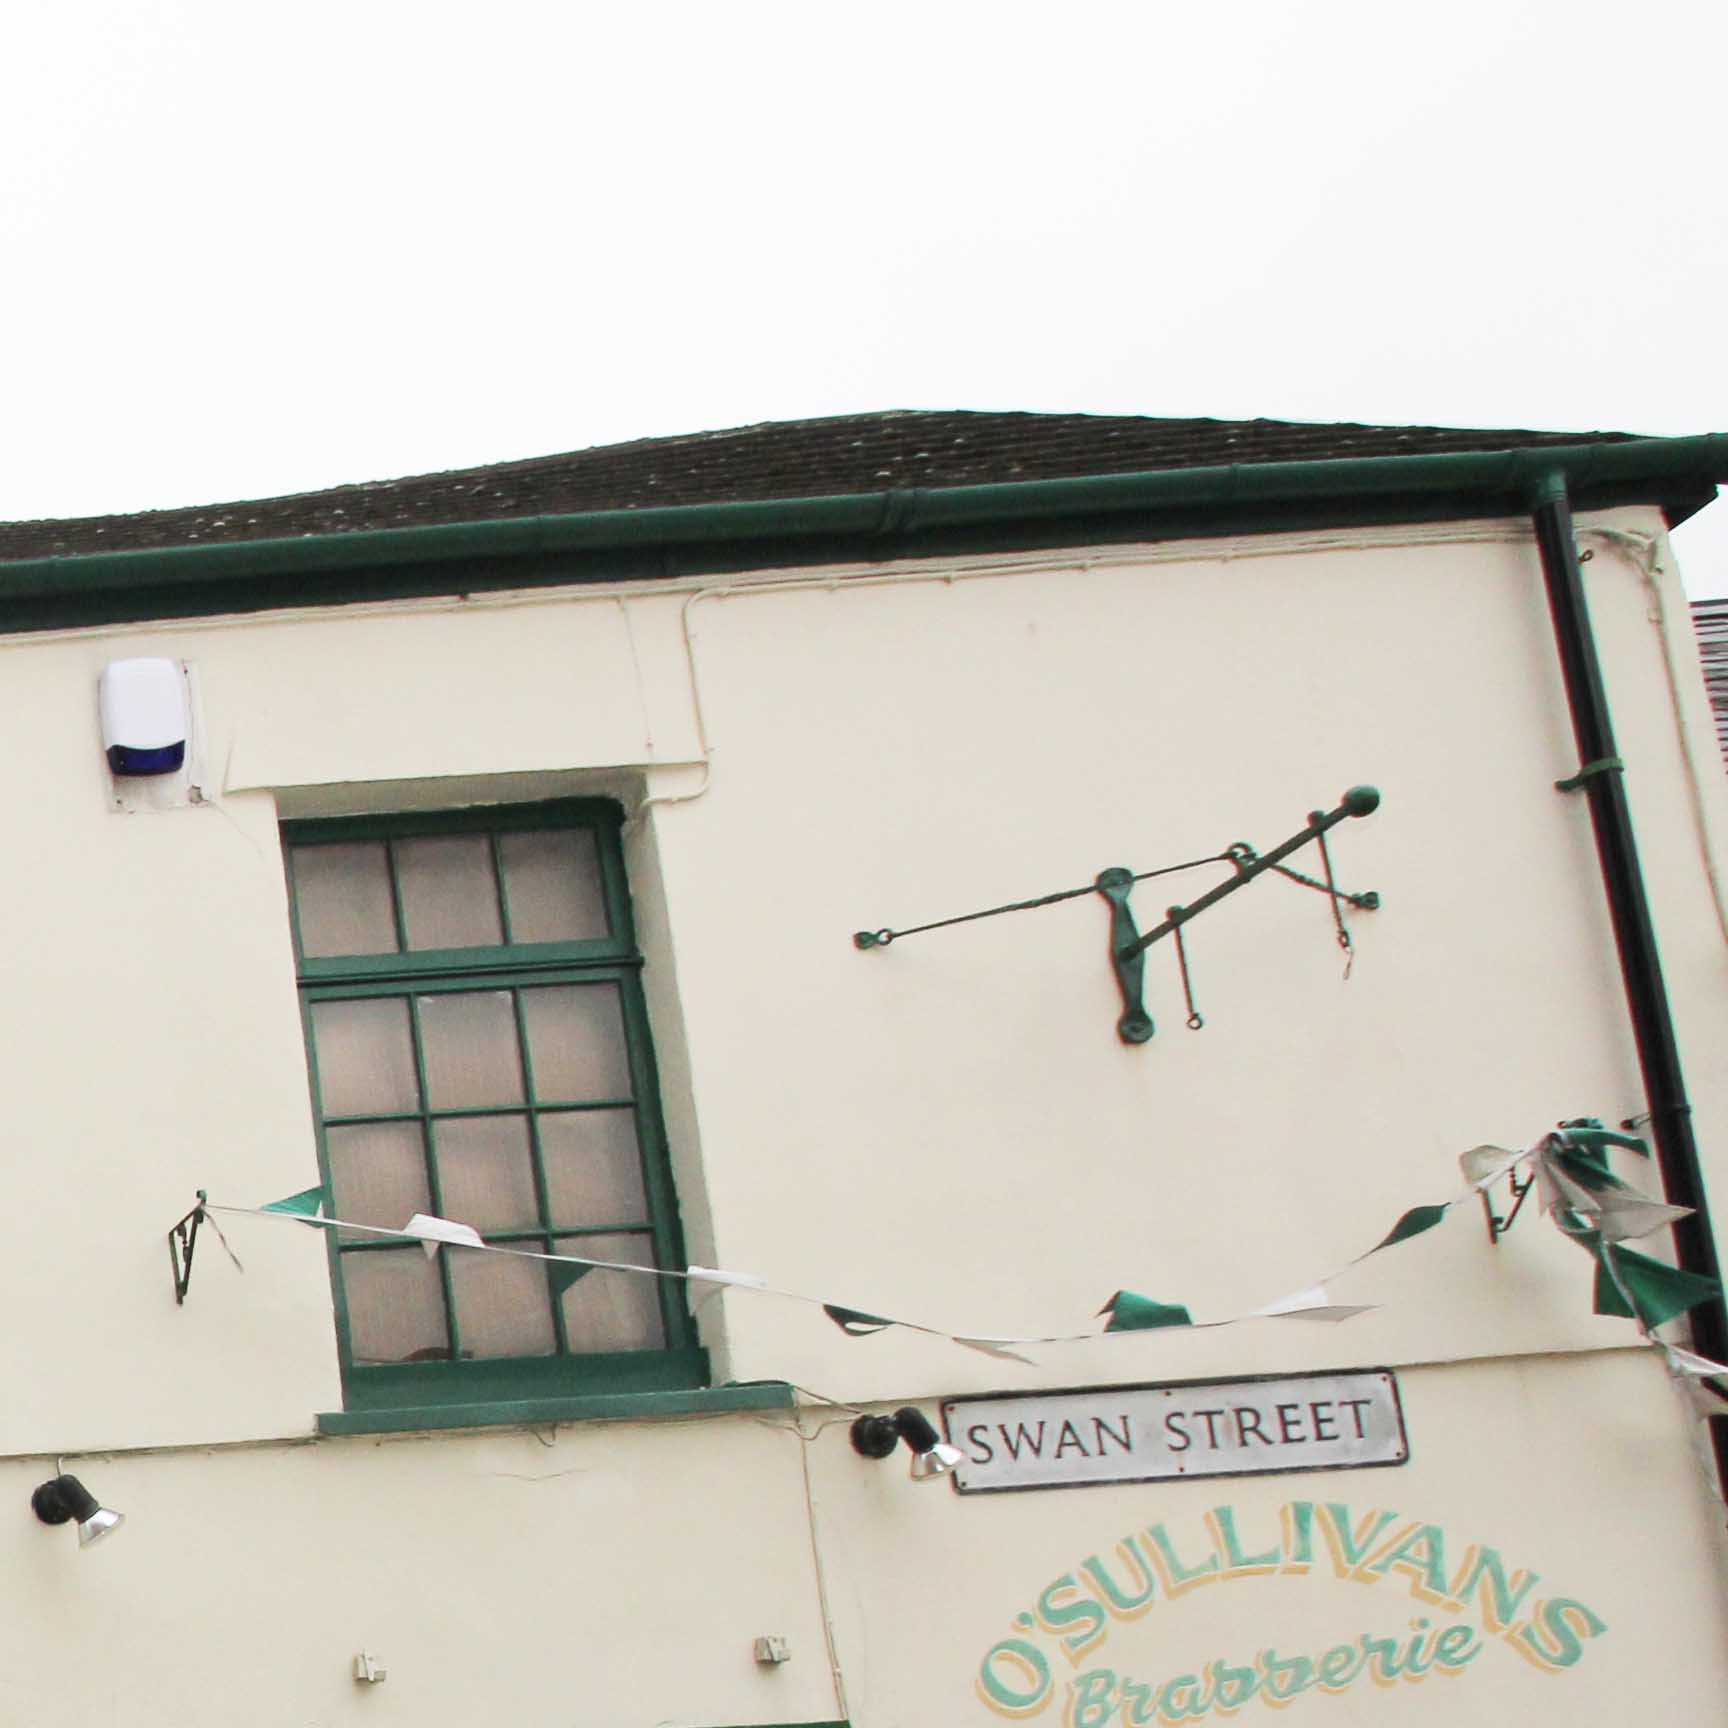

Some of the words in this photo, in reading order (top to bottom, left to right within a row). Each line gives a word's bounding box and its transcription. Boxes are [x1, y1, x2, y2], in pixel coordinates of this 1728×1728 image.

[966, 1415, 1134, 1465] SWAN
[1164, 1398, 1372, 1453] STREET
[975, 1501, 1609, 1719] O'SULLIVANS
